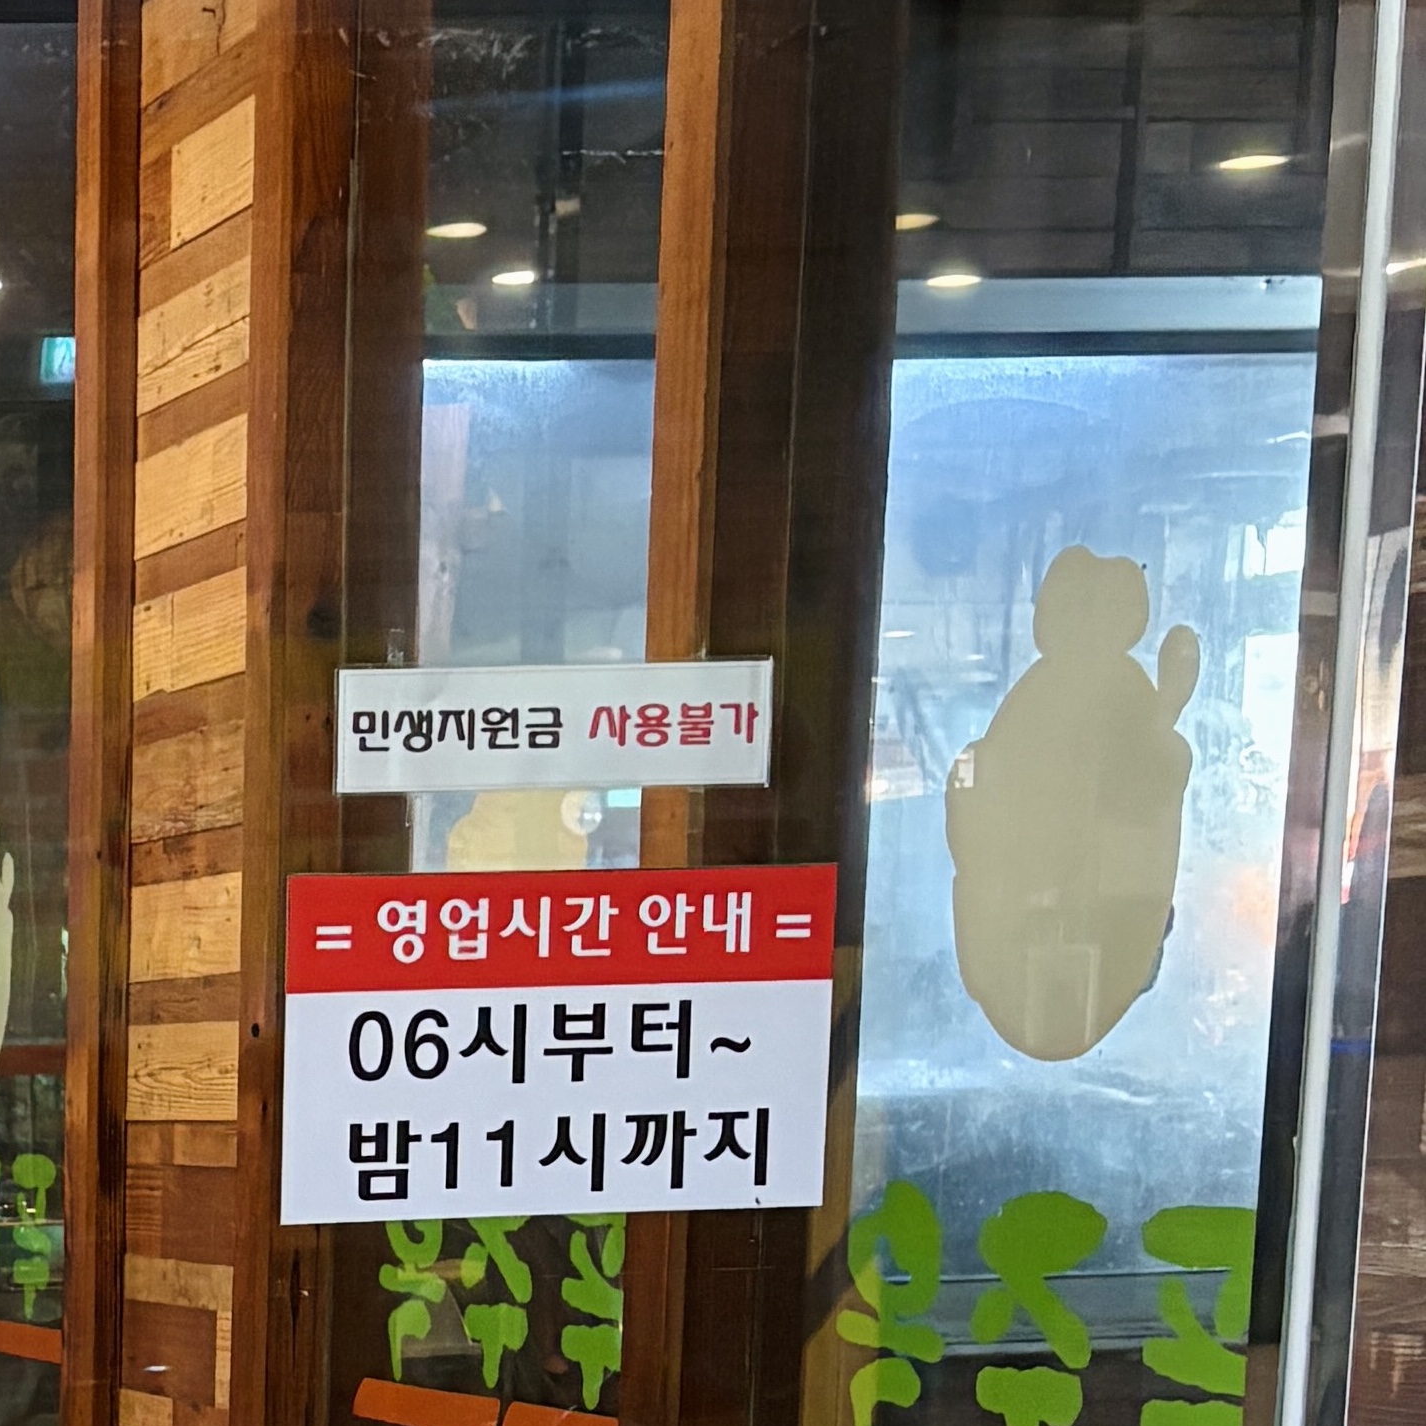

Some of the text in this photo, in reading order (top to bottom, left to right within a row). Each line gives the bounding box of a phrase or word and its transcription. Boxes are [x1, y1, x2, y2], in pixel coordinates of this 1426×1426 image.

[353, 700, 760, 753] 민생지원금 사용불가
[376, 893, 620, 965] 영업시간
[637, 890, 754, 955] 안내
[347, 998, 753, 1085] 06시부터~
[348, 1107, 771, 1203] 밤11시까지
